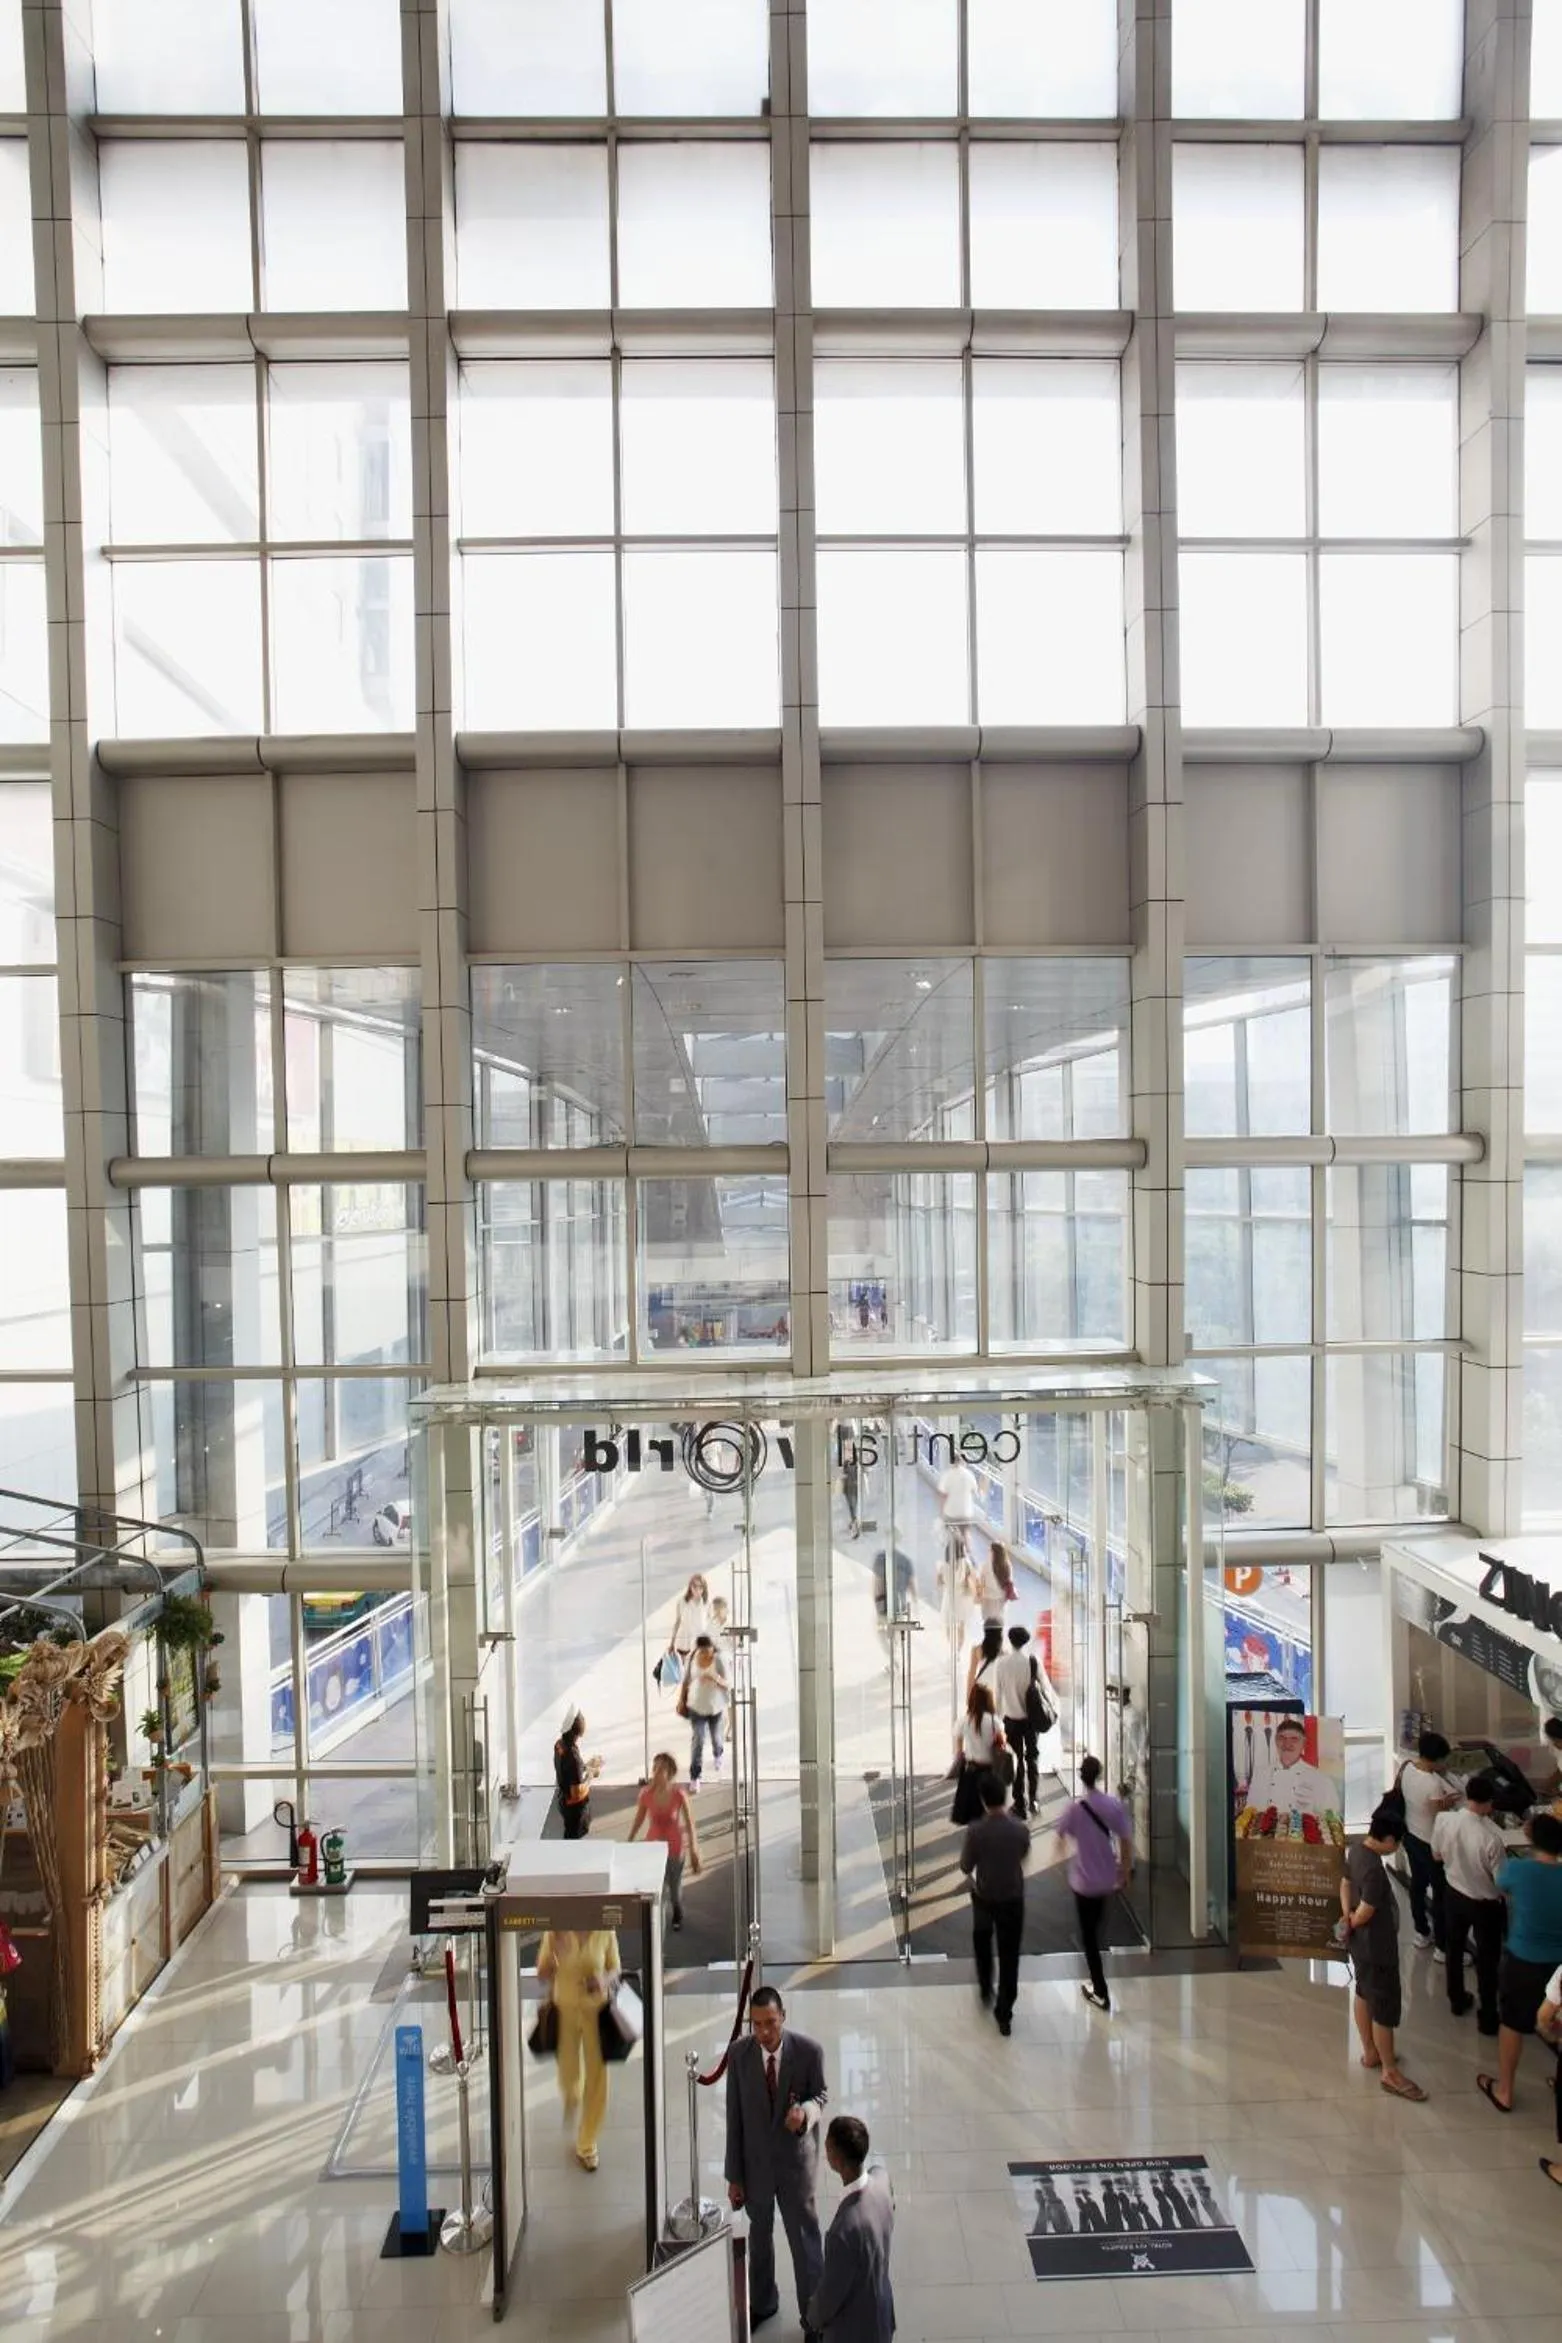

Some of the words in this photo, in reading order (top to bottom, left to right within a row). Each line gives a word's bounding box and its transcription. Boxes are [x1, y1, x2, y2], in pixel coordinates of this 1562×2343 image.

[1234, 1566, 1253, 1589] P
[1256, 1892, 1294, 1906] Happy
[1299, 1895, 1329, 1908] Hour
